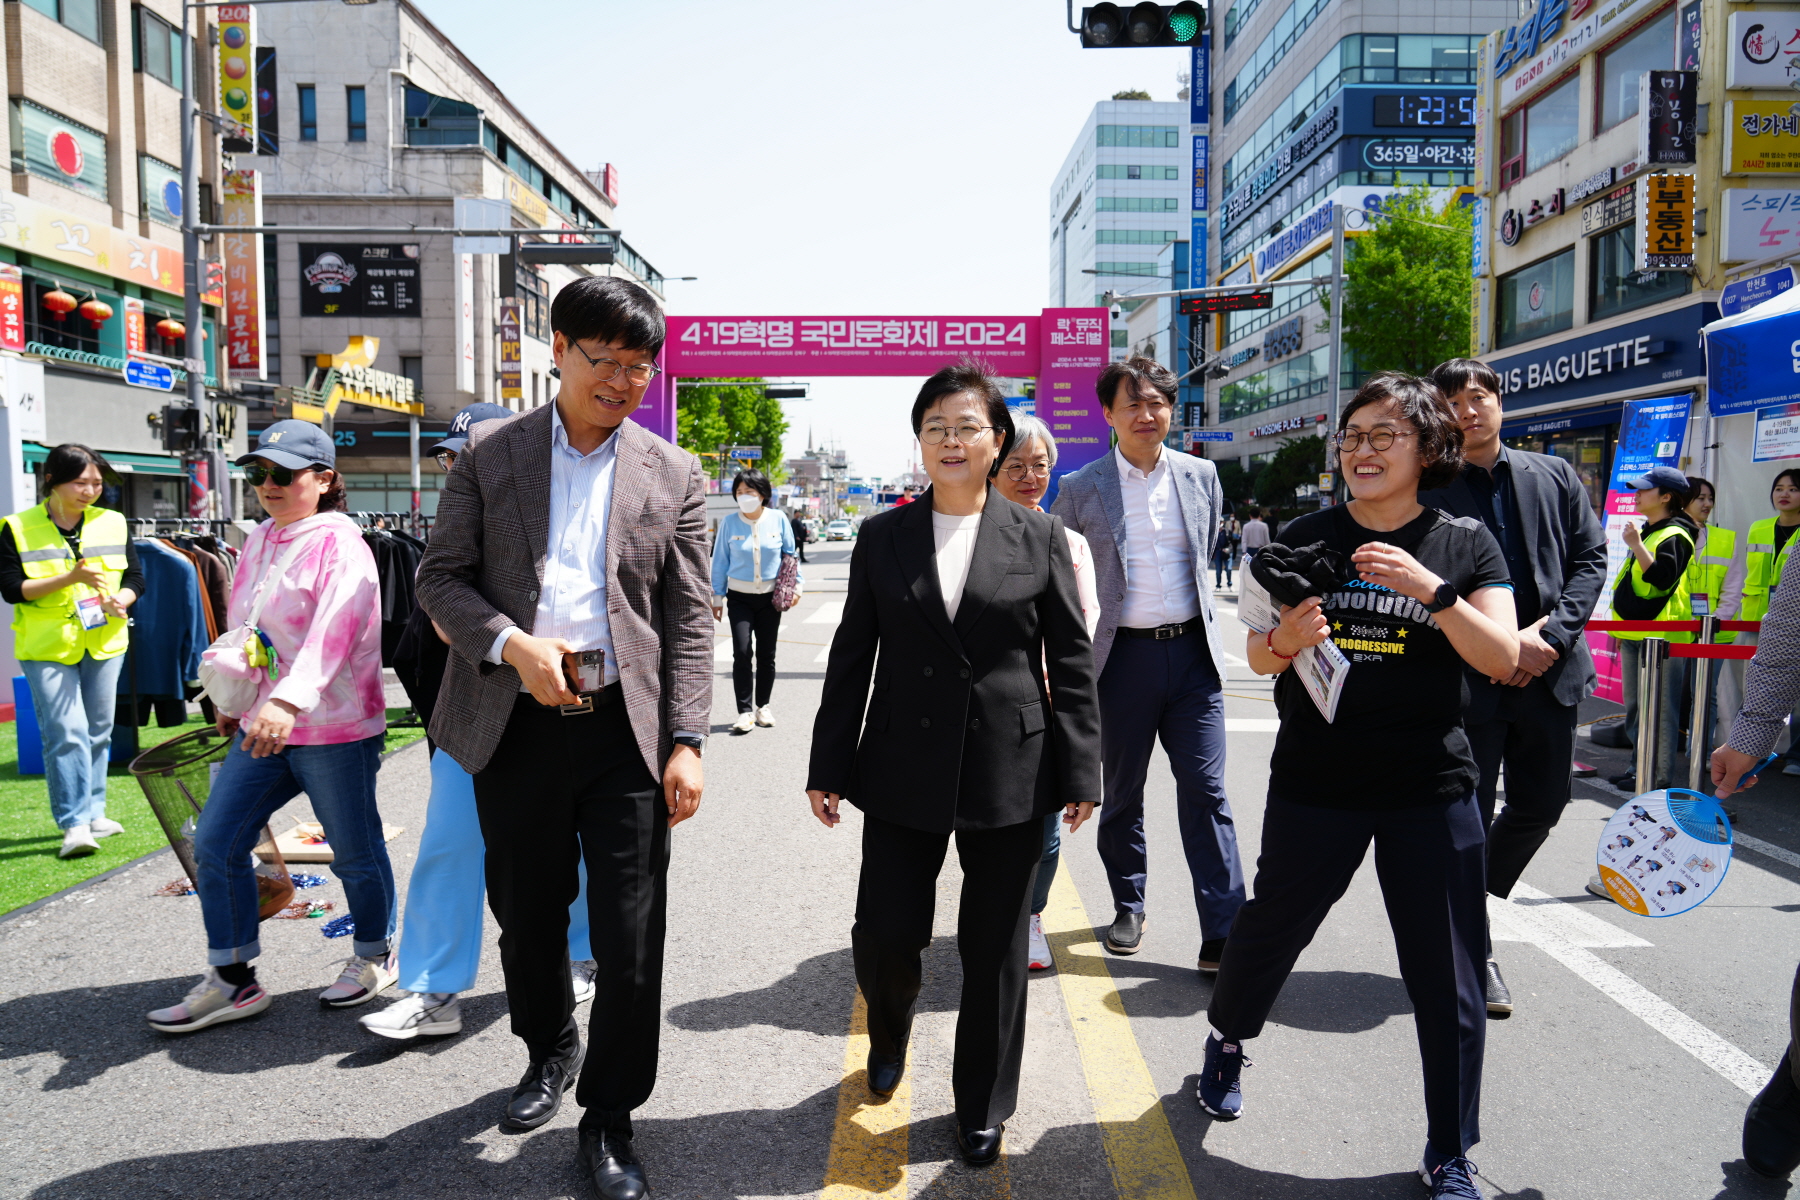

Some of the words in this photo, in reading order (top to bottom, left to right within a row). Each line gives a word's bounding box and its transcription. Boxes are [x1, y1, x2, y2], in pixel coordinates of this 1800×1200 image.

[1399, 96, 1477, 126] 1:23:5
[1660, 73, 1685, 148] 미용실
[1742, 113, 1798, 136] 전가네
[1658, 151, 1686, 161] HAIR
[1743, 160, 1765, 168] 24시간
[1657, 177, 1685, 188] 골드
[1583, 203, 1603, 231] 일식
[1655, 190, 1685, 252] 부동산
[362, 248, 389, 258] 스크린
[1648, 256, 1692, 265] 992-3000
[1473, 265, 1481, 275] 3F
[1747, 277, 1767, 291] 한천로
[1724, 295, 1736, 305] 1037
[1777, 280, 1790, 290] 1041
[324, 304, 339, 314] 3F
[1057, 318, 1070, 331] 락
[1076, 318, 1101, 331] 뮤직
[504, 328, 517, 340] 1%
[801, 320, 938, 347] 국민문화제
[945, 322, 1026, 345] 2024
[1051, 332, 1101, 345] 페스티벌
[502, 342, 520, 361] PC
[502, 362, 520, 372] ARENA
[1528, 335, 1650, 389] BAGUETTE
[1258, 421, 1282, 436] TWOSOME
[1283, 417, 1301, 431] PLACE
[1528, 424, 1542, 432] PARIS
[1543, 420, 1571, 430] BAGUETTE
[335, 431, 356, 446] 25
[1334, 638, 1405, 654] PROGRESSIVE
[1353, 653, 1382, 662] EXR
